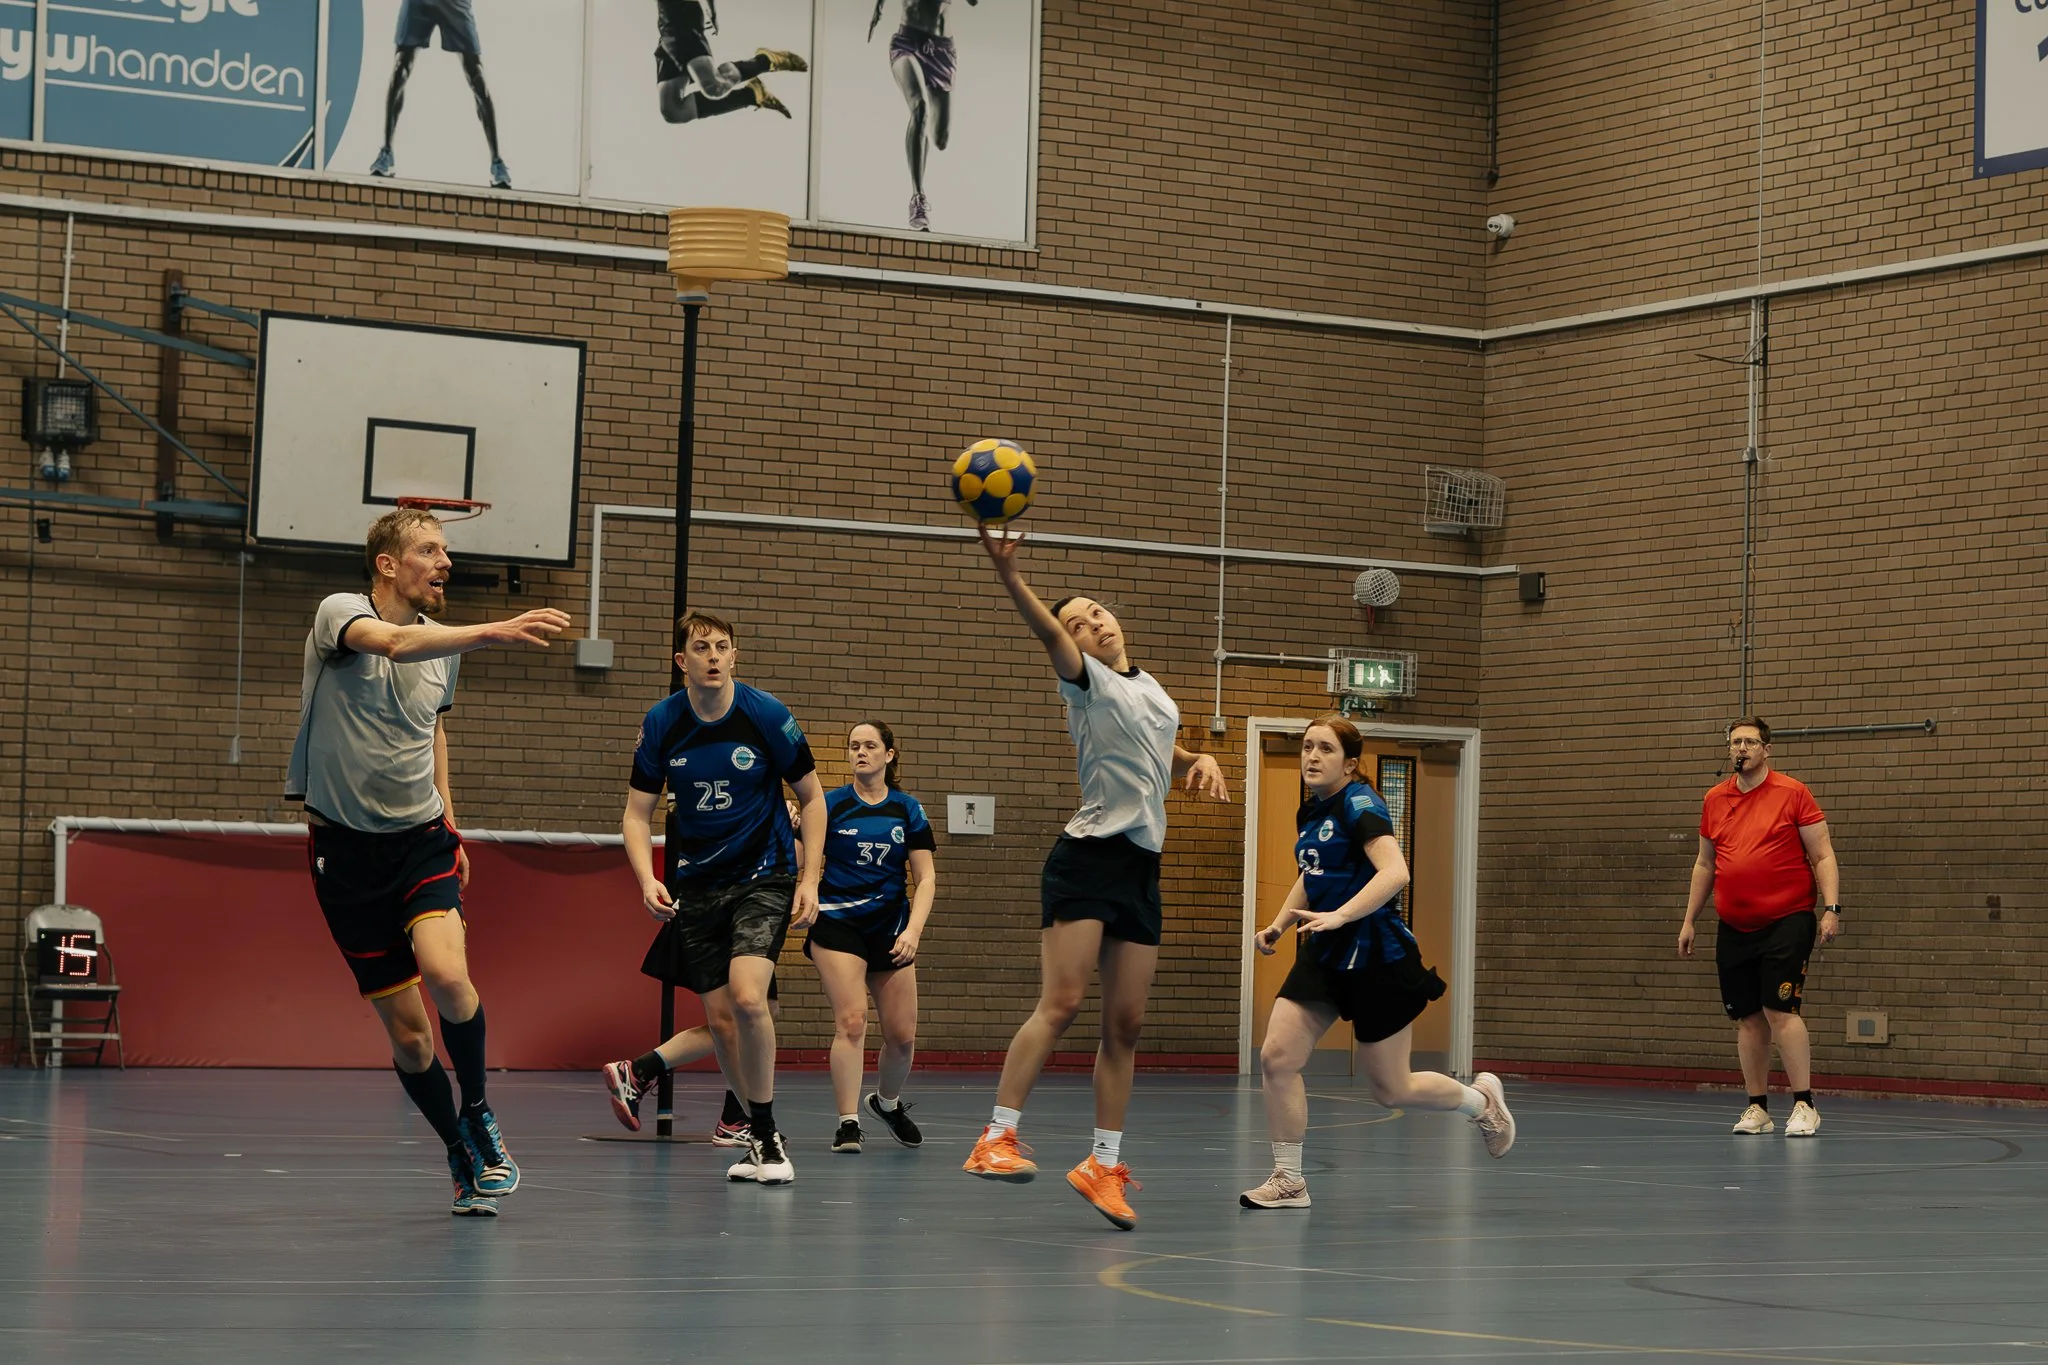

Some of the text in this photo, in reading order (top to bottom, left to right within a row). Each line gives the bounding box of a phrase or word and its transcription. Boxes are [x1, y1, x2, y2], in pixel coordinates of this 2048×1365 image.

[693, 780, 733, 811] 25
[856, 842, 891, 866] 37
[59, 934, 91, 976] 15
